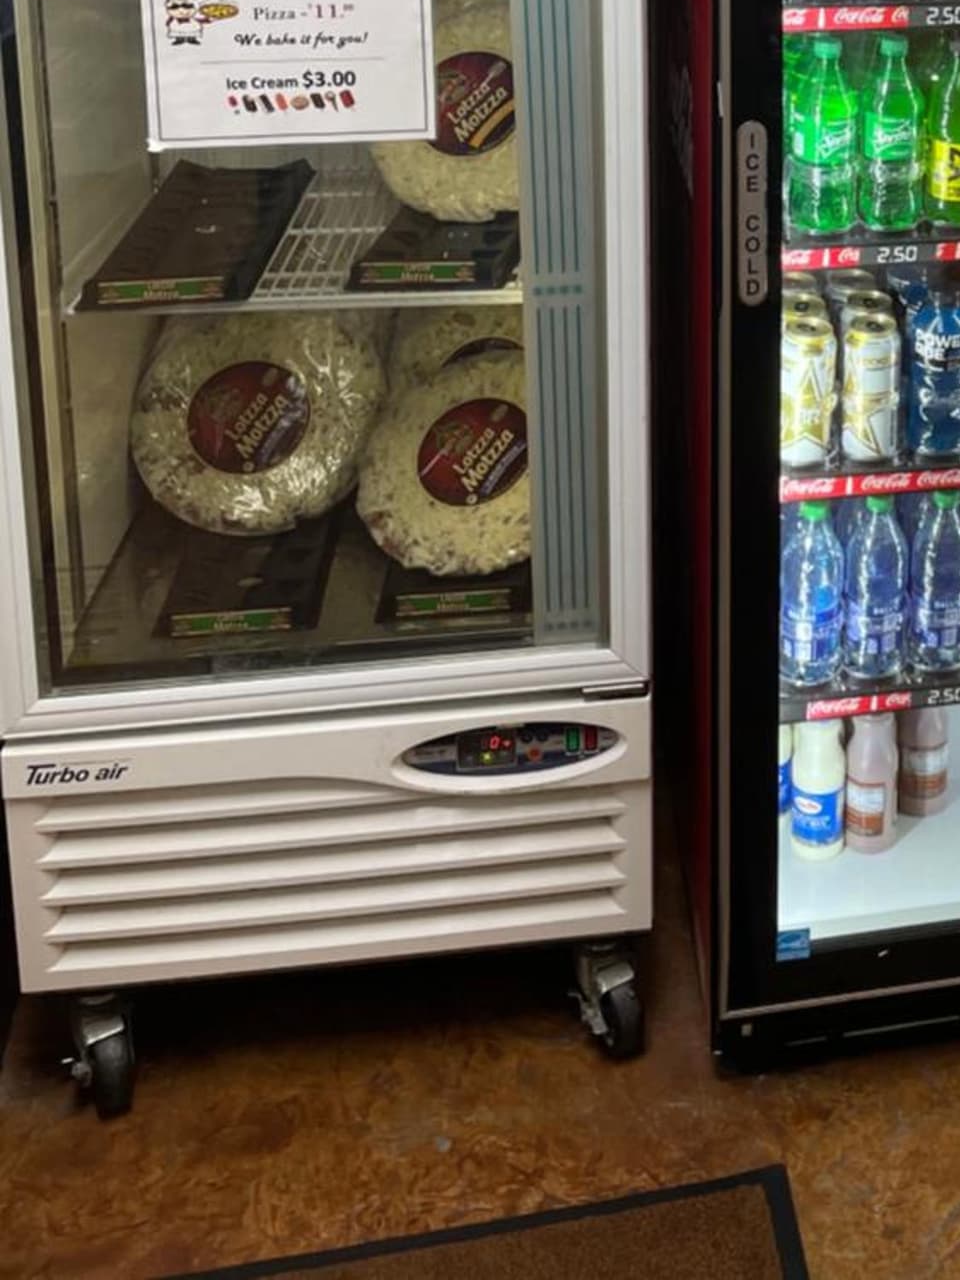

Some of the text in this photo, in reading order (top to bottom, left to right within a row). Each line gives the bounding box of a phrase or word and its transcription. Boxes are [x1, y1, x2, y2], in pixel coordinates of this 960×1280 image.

[253, 6, 296, 21] Pizza
[234, 31, 369, 49] We bake it for you!
[226, 70, 356, 90] Ice Cream $3.00
[447, 82, 491, 124] Lotzza
[454, 87, 508, 142] Motzza
[744, 132, 761, 296] ICE COLD
[877, 246, 918, 263] 2.50
[235, 394, 289, 458] Motzza
[452, 427, 495, 474] Lotzza
[461, 429, 514, 492] Motzza
[27, 762, 128, 785] Turbo air
